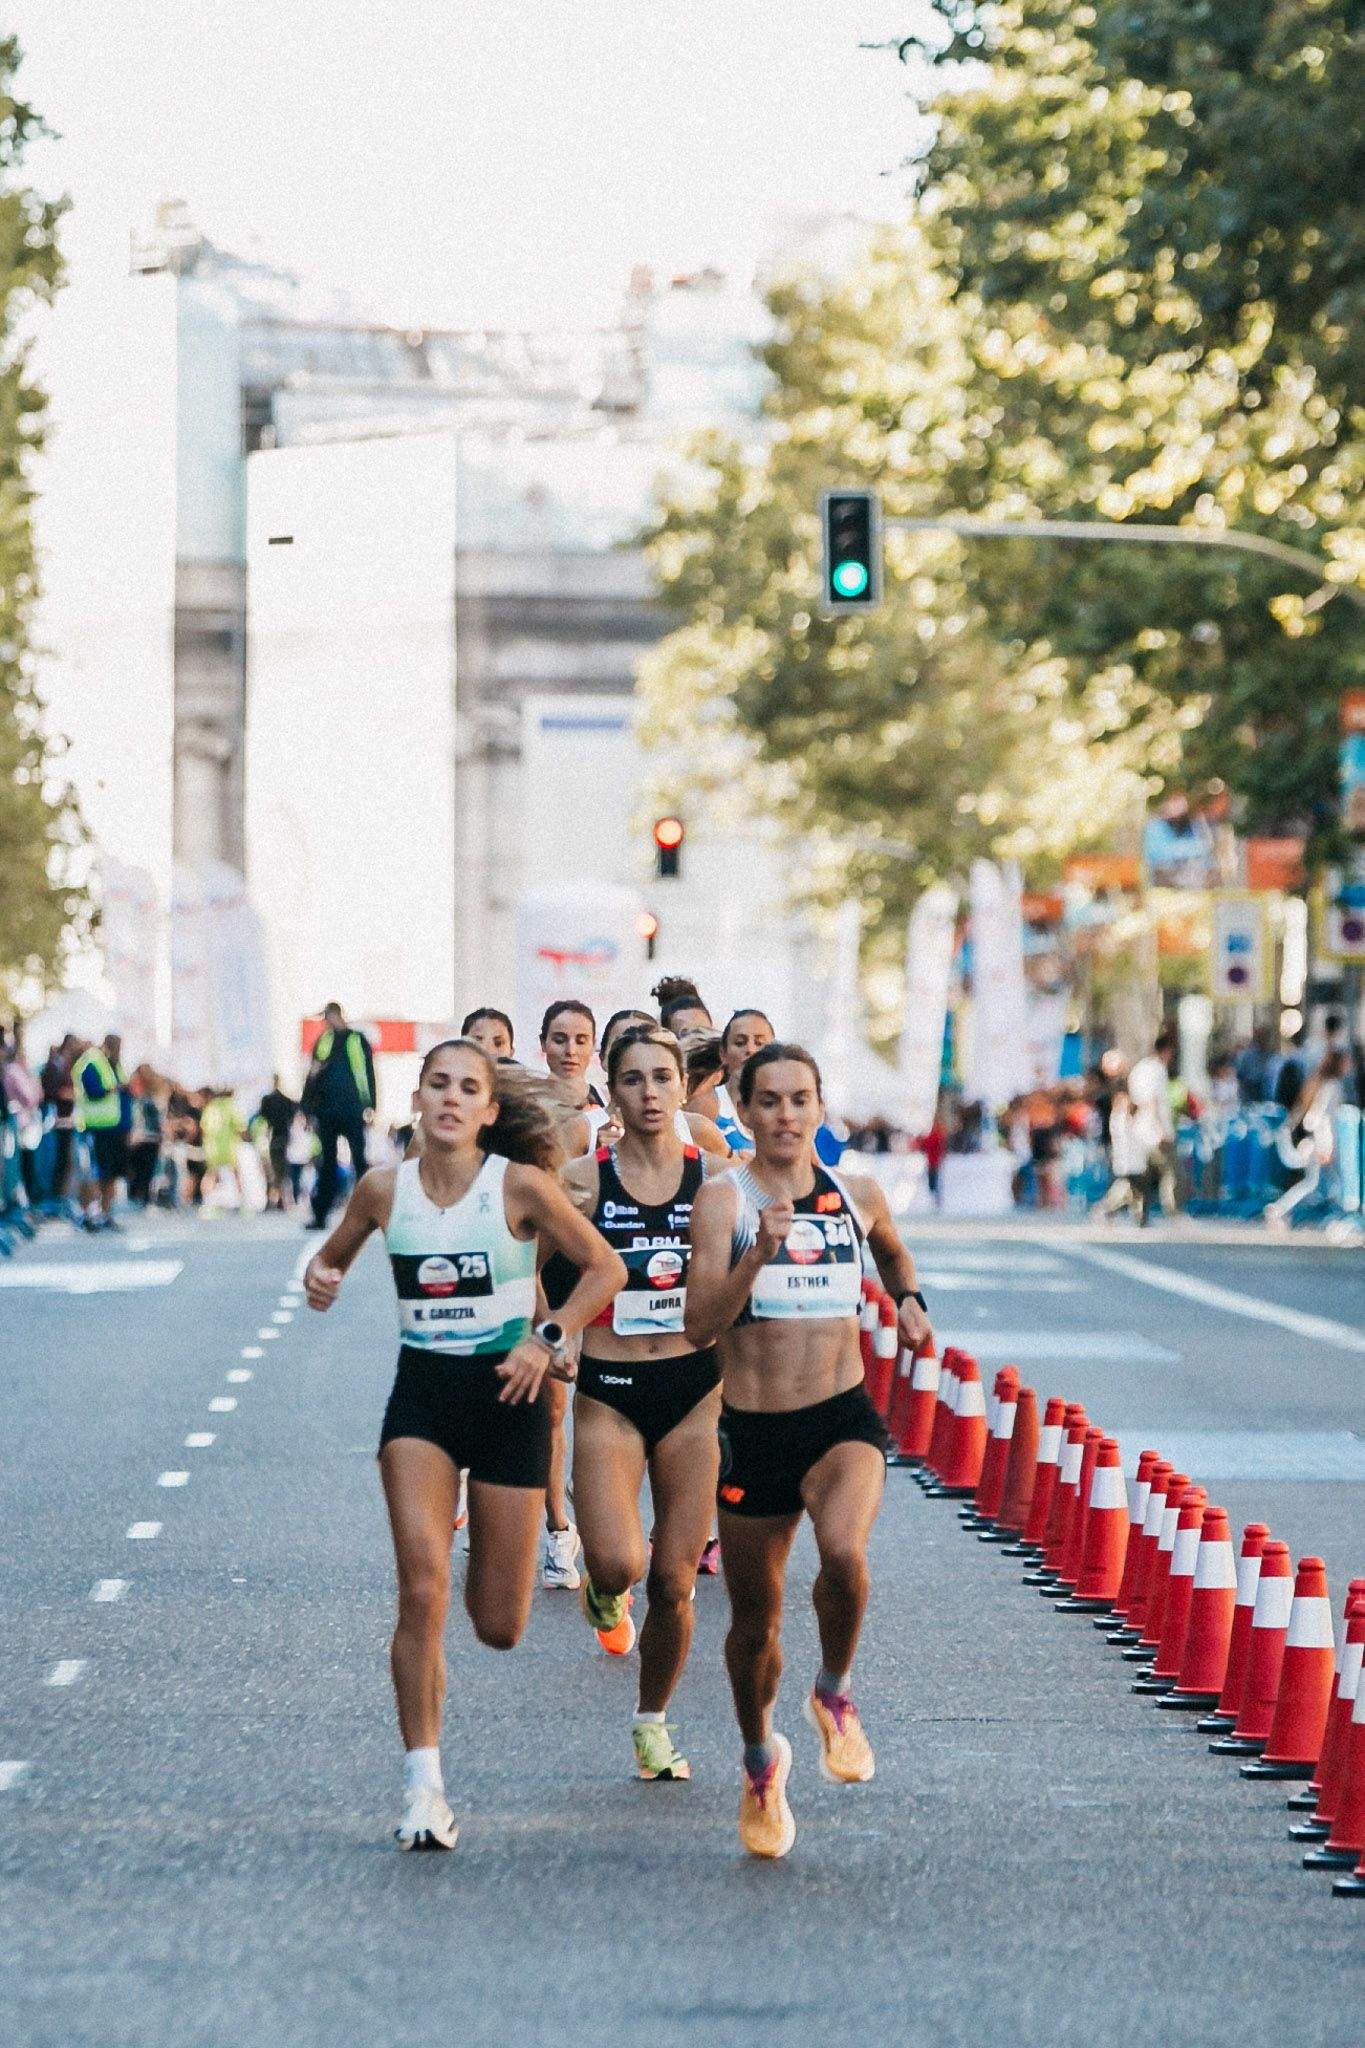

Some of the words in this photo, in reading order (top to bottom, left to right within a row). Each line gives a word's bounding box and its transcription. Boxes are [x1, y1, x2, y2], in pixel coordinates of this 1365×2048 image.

[458, 1254, 487, 1278] 25
[787, 1276, 830, 1289] ESTHER
[649, 1296, 682, 1311] LAURA
